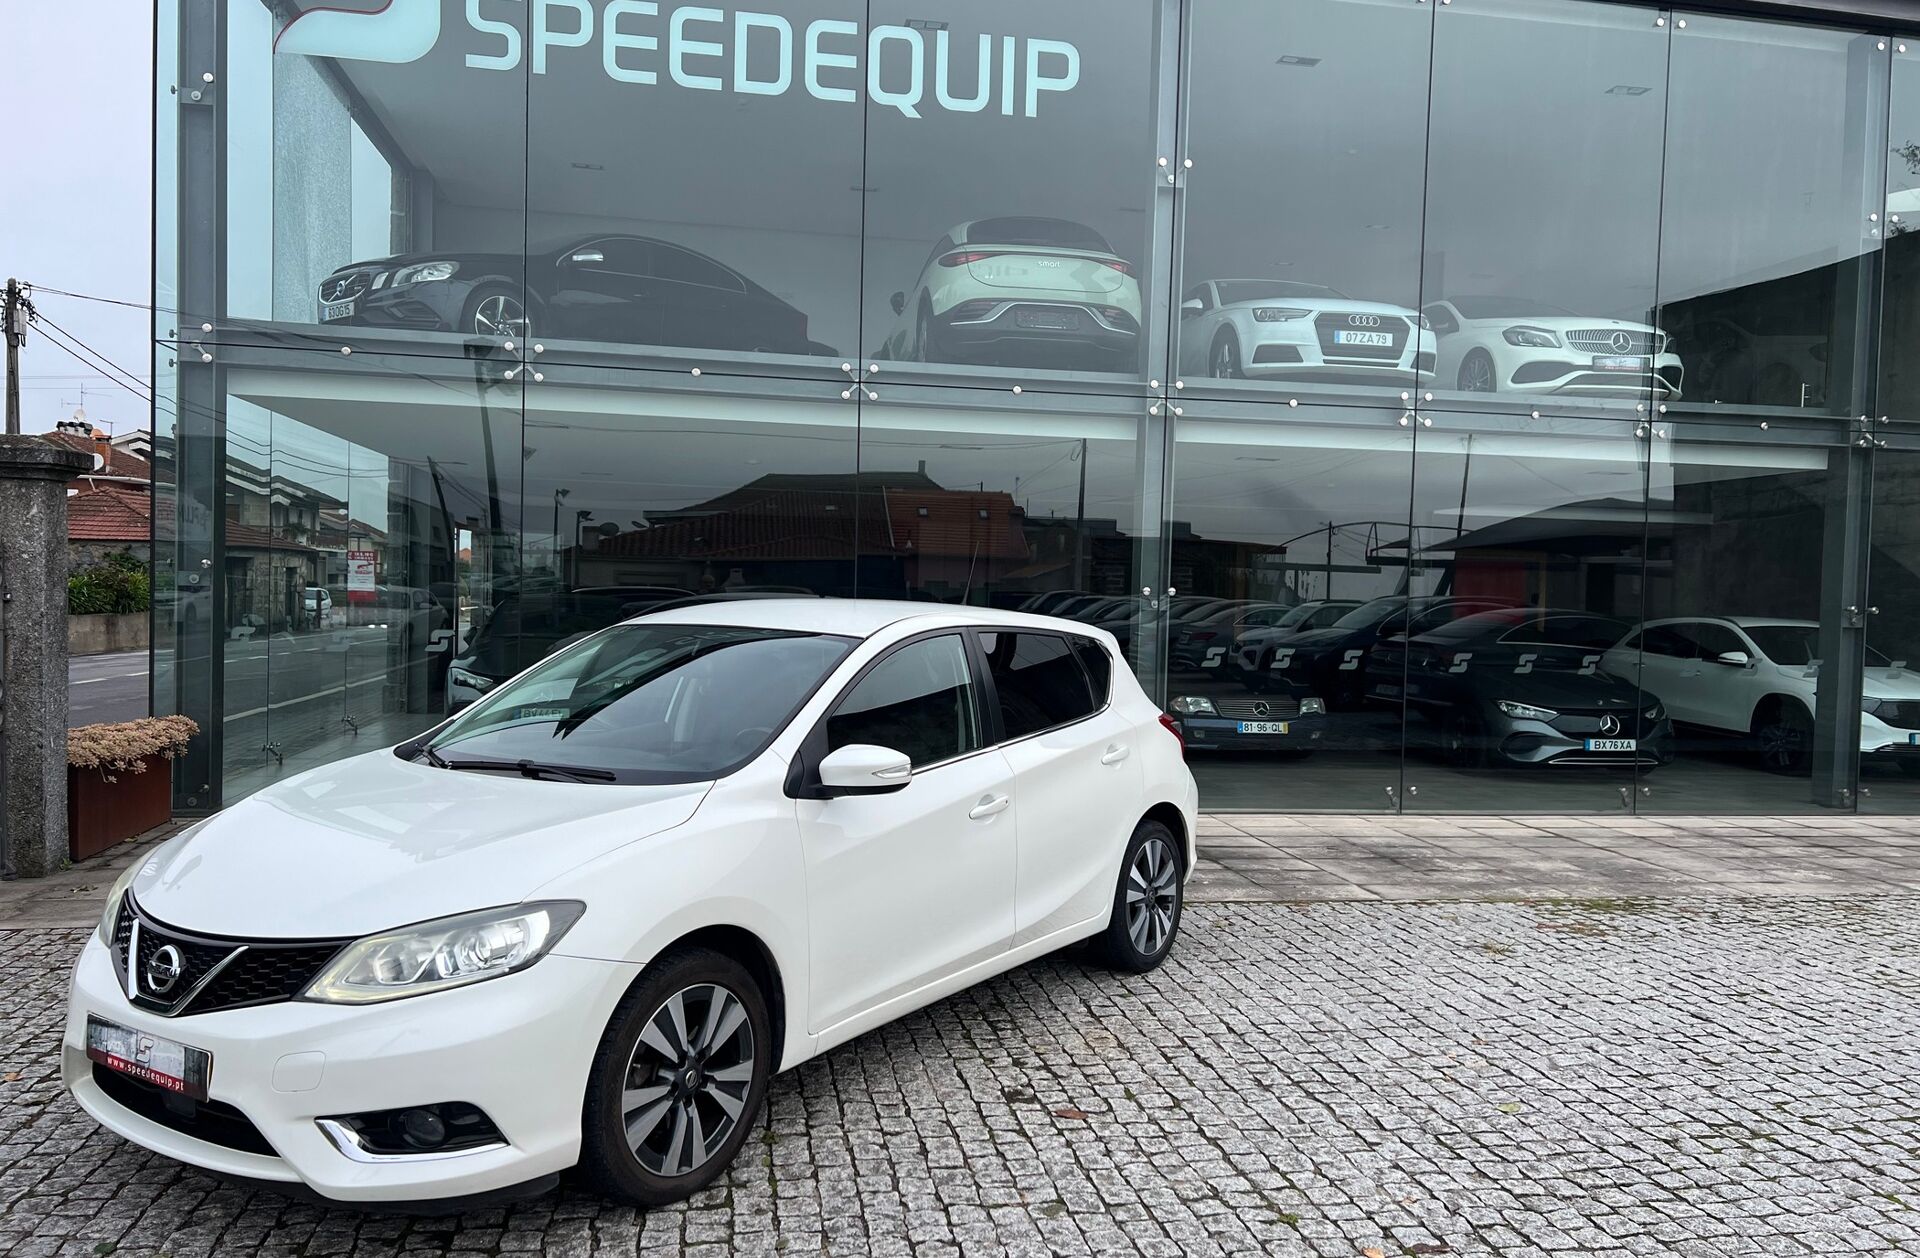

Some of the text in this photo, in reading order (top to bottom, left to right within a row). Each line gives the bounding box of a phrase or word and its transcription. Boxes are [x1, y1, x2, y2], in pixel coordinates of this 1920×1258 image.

[465, 0, 1081, 119] SPEEDEQUIP
[1038, 260, 1061, 268] smart
[106, 1056, 184, 1092] www.speedequip.pt
